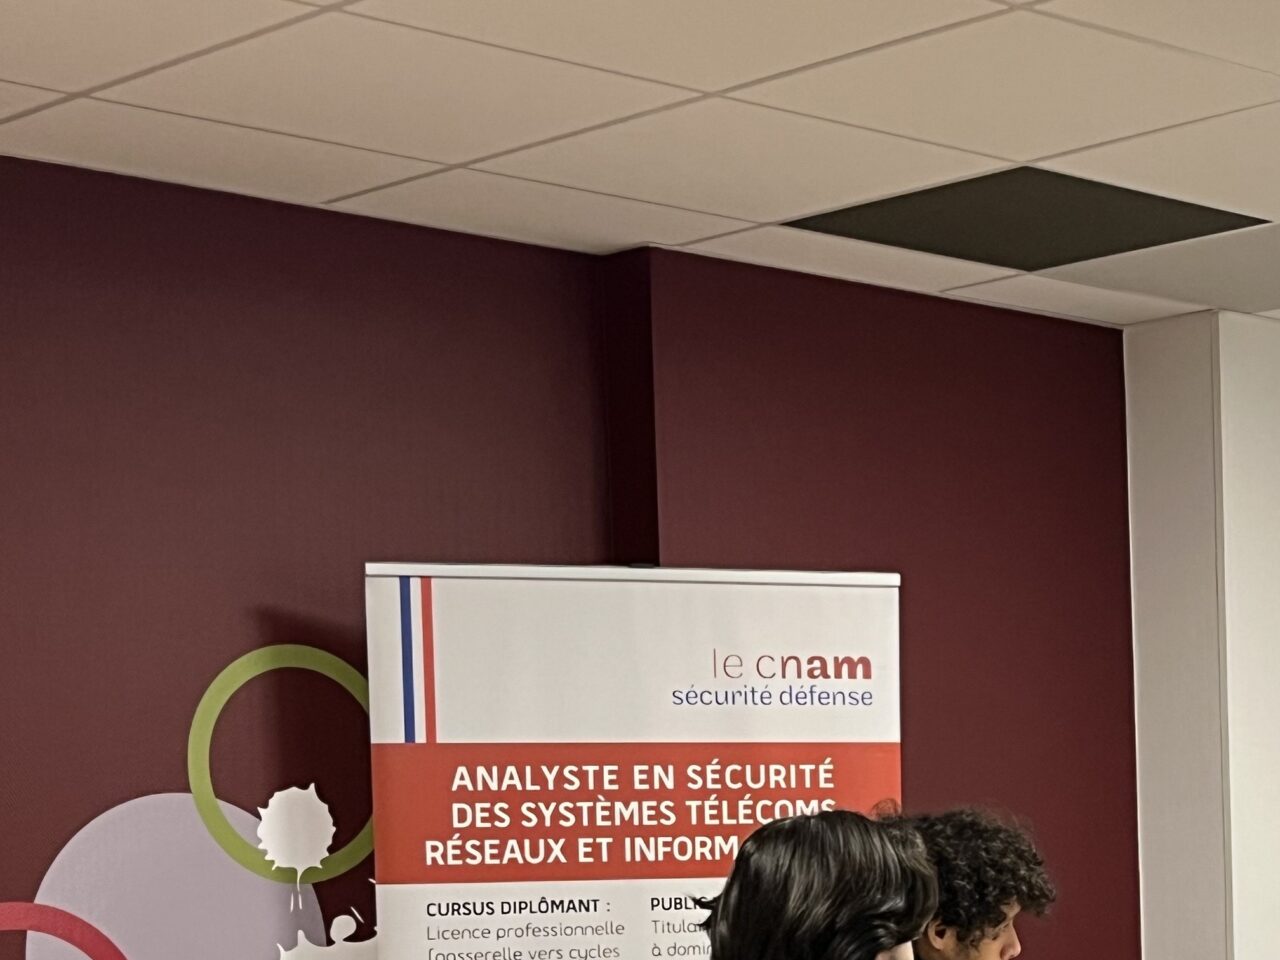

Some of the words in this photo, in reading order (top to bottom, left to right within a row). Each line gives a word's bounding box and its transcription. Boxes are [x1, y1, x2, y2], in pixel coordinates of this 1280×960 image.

[713, 648, 743, 679] le
[756, 654, 872, 680] cnam
[672, 684, 772, 706] sécurité
[779, 684, 873, 706] défense
[451, 765, 619, 792] ANALYSTE
[633, 764, 674, 790] EN
[686, 757, 835, 790] SÉCURITÉ
[452, 802, 511, 828] DES
[521, 794, 676, 827] SYSTÈMES
[425, 833, 568, 866] RÉSEAUX
[577, 837, 613, 863] ET
[426, 901, 495, 917] CURSUS
[500, 896, 600, 915] DIPLÔMANT
[426, 925, 491, 941] Licence
[496, 921, 625, 941] professionnelle
[528, 947, 564, 960] vers
[652, 943, 662, 957] à
